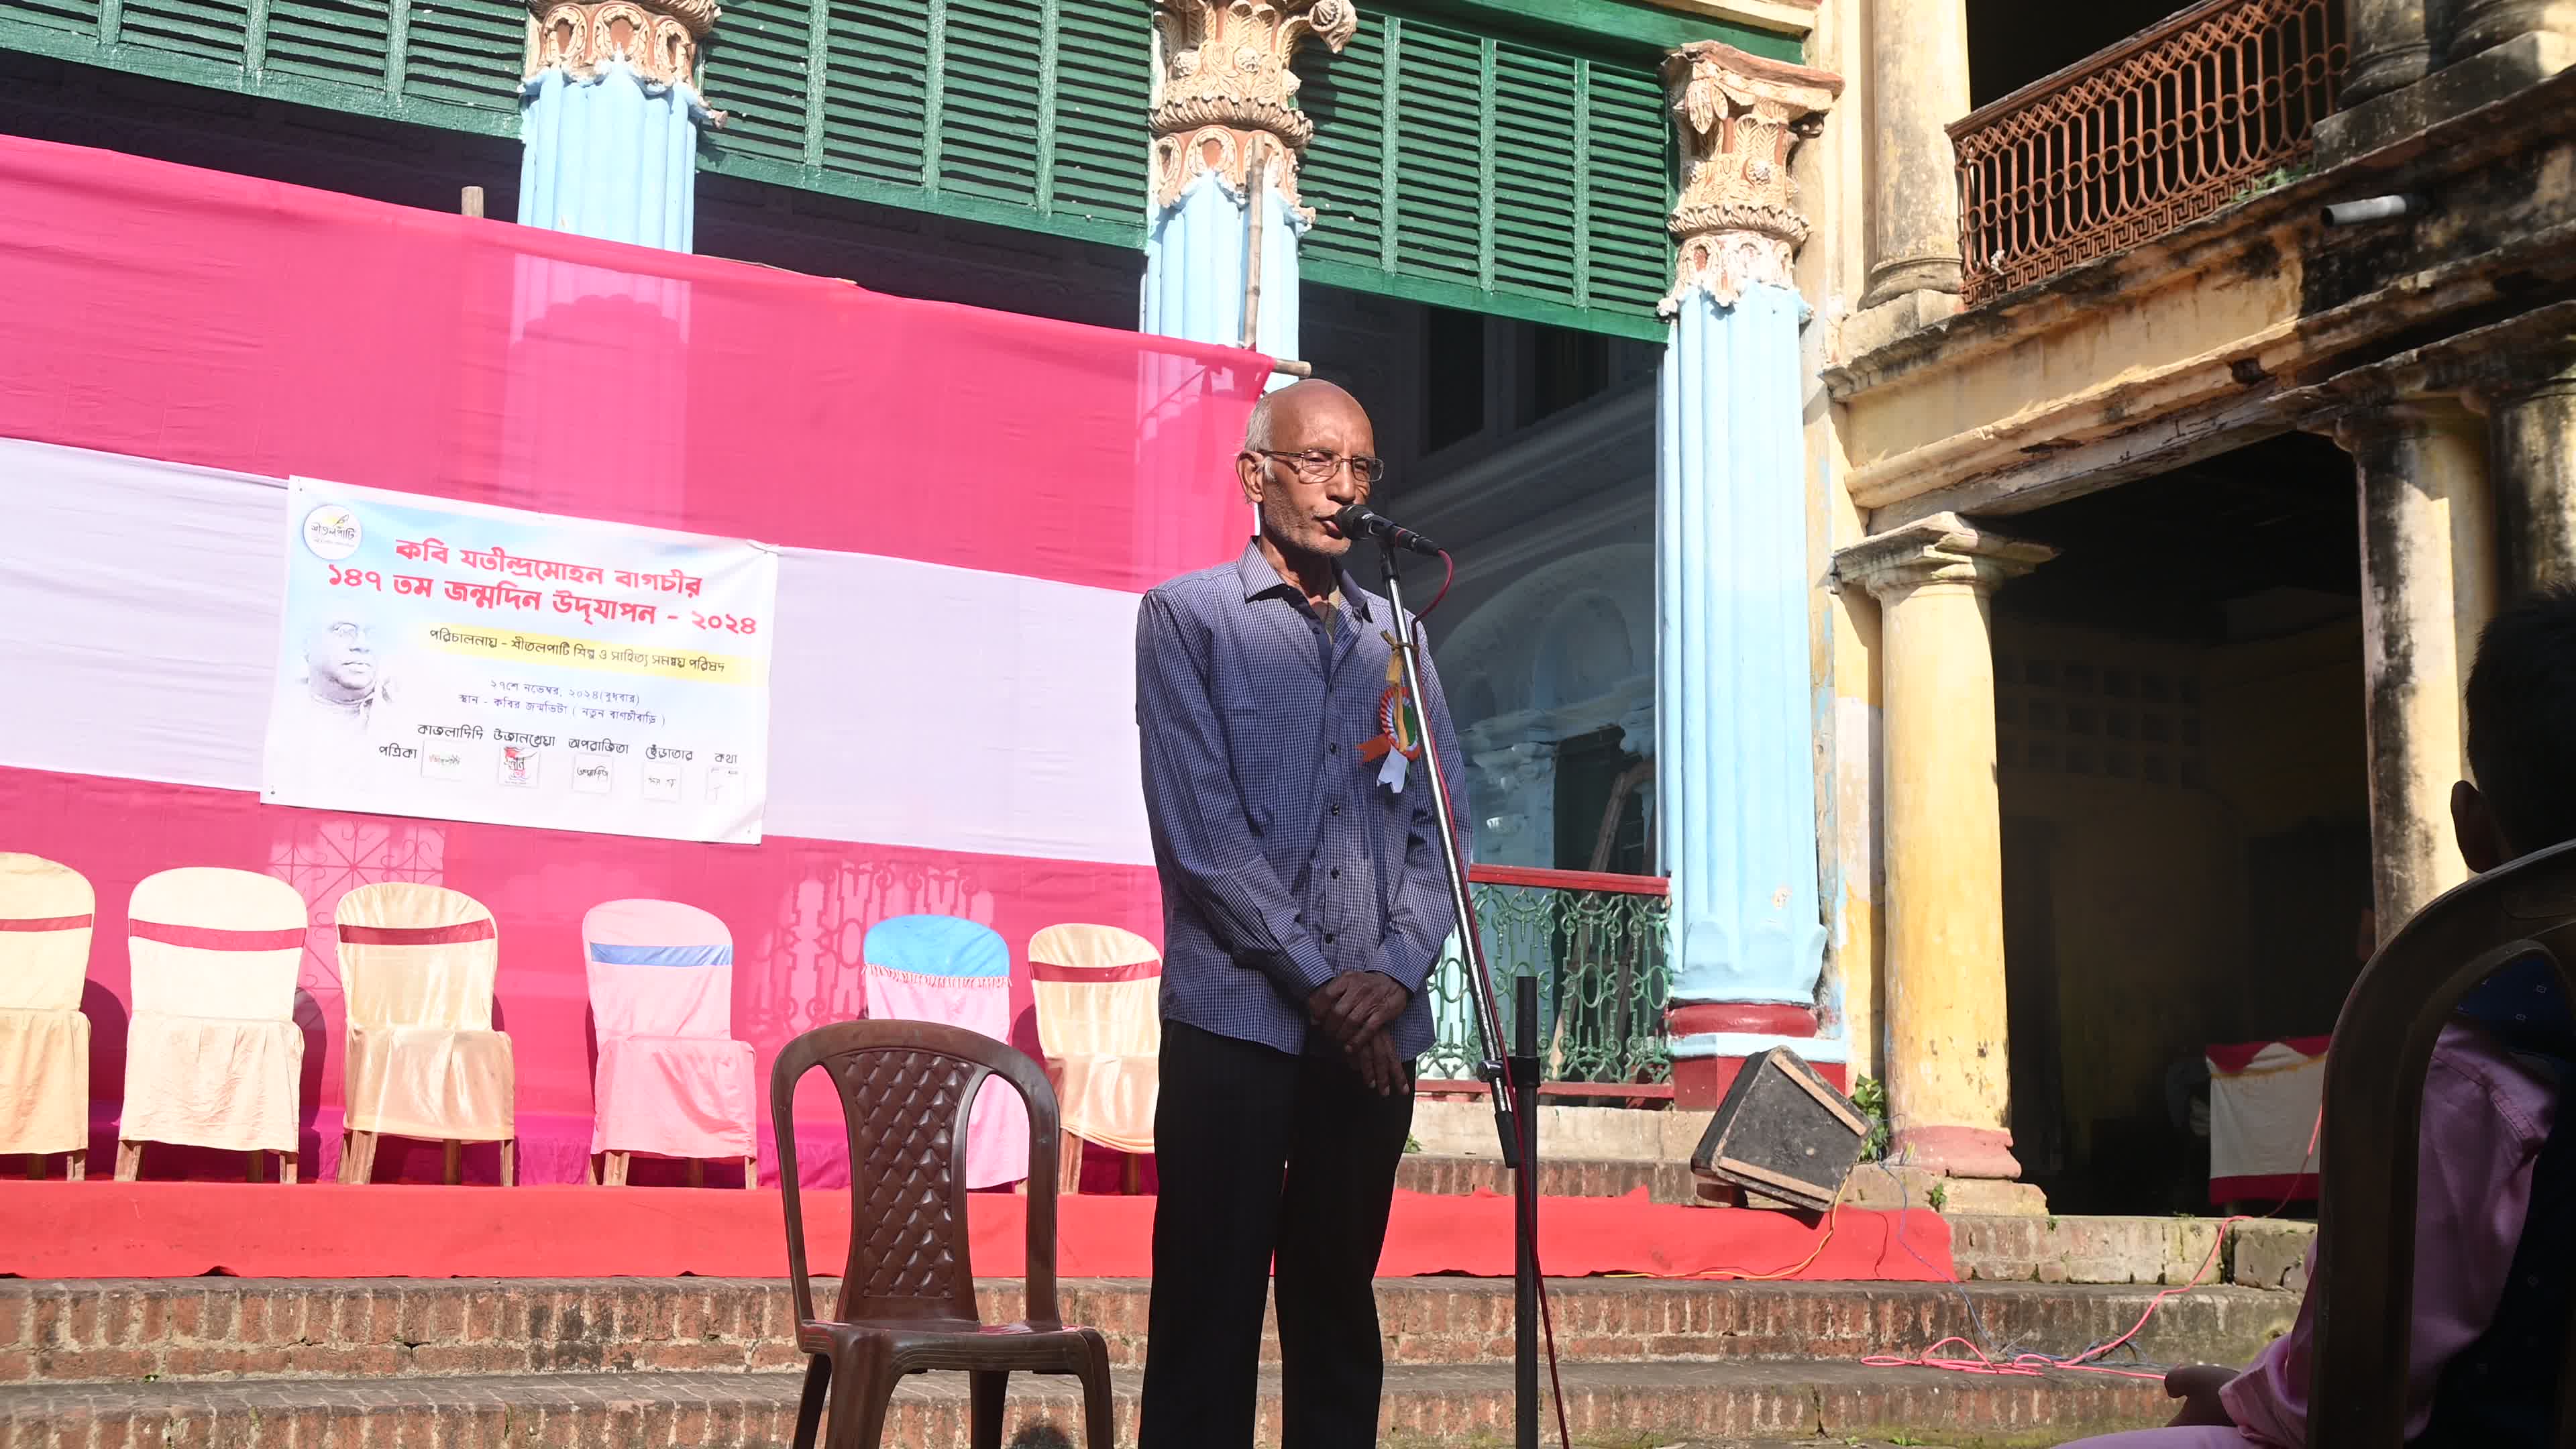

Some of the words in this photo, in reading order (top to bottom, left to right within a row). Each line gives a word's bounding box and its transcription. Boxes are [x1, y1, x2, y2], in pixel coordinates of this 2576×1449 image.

[396, 537, 449, 564] কবি
[460, 547, 604, 584] যতীন্দ্রমোহন
[614, 569, 702, 598] বাগচীর
[329, 564, 381, 591] ১৪৭
[393, 574, 433, 598] তম
[444, 580, 542, 610] জন্মদিন
[692, 610, 756, 634] ২০২৪
[430, 628, 498, 648] পরিচালনায়
[511, 636, 570, 655] শীতলপাটি
[599, 649, 607, 659] ও
[611, 649, 648, 667] সাহিত্য
[689, 656, 724, 672] পরিষদ
[494, 697, 521, 709] কবির
[582, 707, 604, 718] নতুন
[378, 743, 417, 759] পত্রিকা
[417, 724, 484, 740] কাজলাদিদি
[494, 728, 555, 747] উজানখেয়া
[568, 738, 629, 754] অপরাজিতা
[714, 753, 738, 764] কথা
